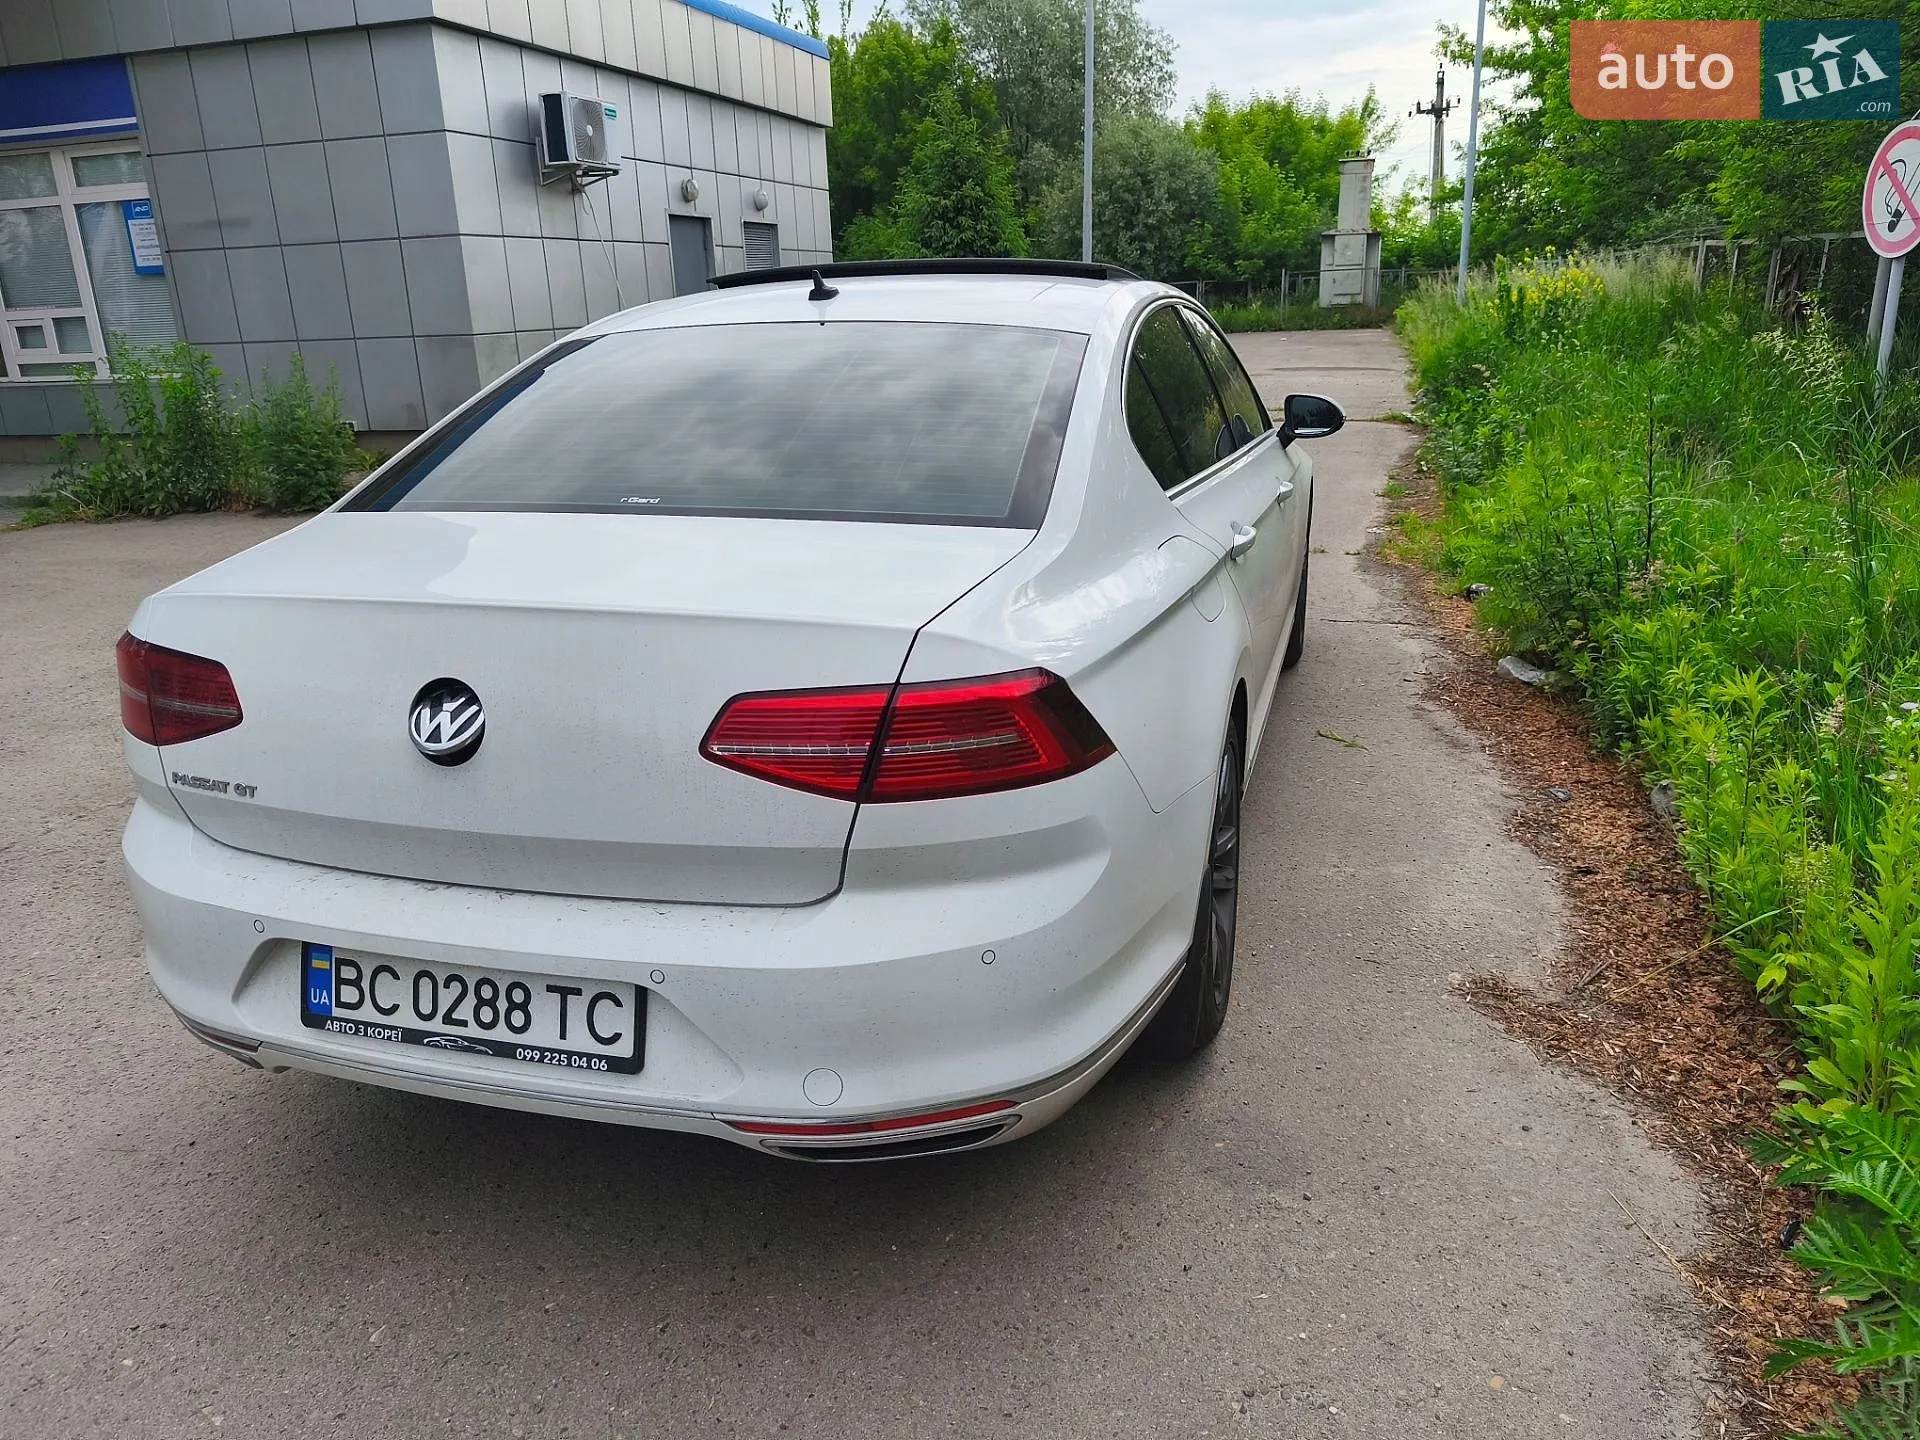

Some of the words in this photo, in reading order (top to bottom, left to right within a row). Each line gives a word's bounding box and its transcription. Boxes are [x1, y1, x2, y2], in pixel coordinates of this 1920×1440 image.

[172, 771, 230, 794] PASSAT
[233, 782, 258, 799] GT
[311, 987, 329, 1006] UA
[334, 957, 401, 1016] BC
[412, 969, 532, 1035] 0288
[546, 984, 624, 1046] TC
[325, 1019, 356, 1034] АВТО
[367, 1026, 403, 1042] КОРЕЇ
[516, 1048, 540, 1062] 099
[543, 1051, 568, 1066] 225
[571, 1055, 588, 1068] 04
[591, 1058, 608, 1071] 06
